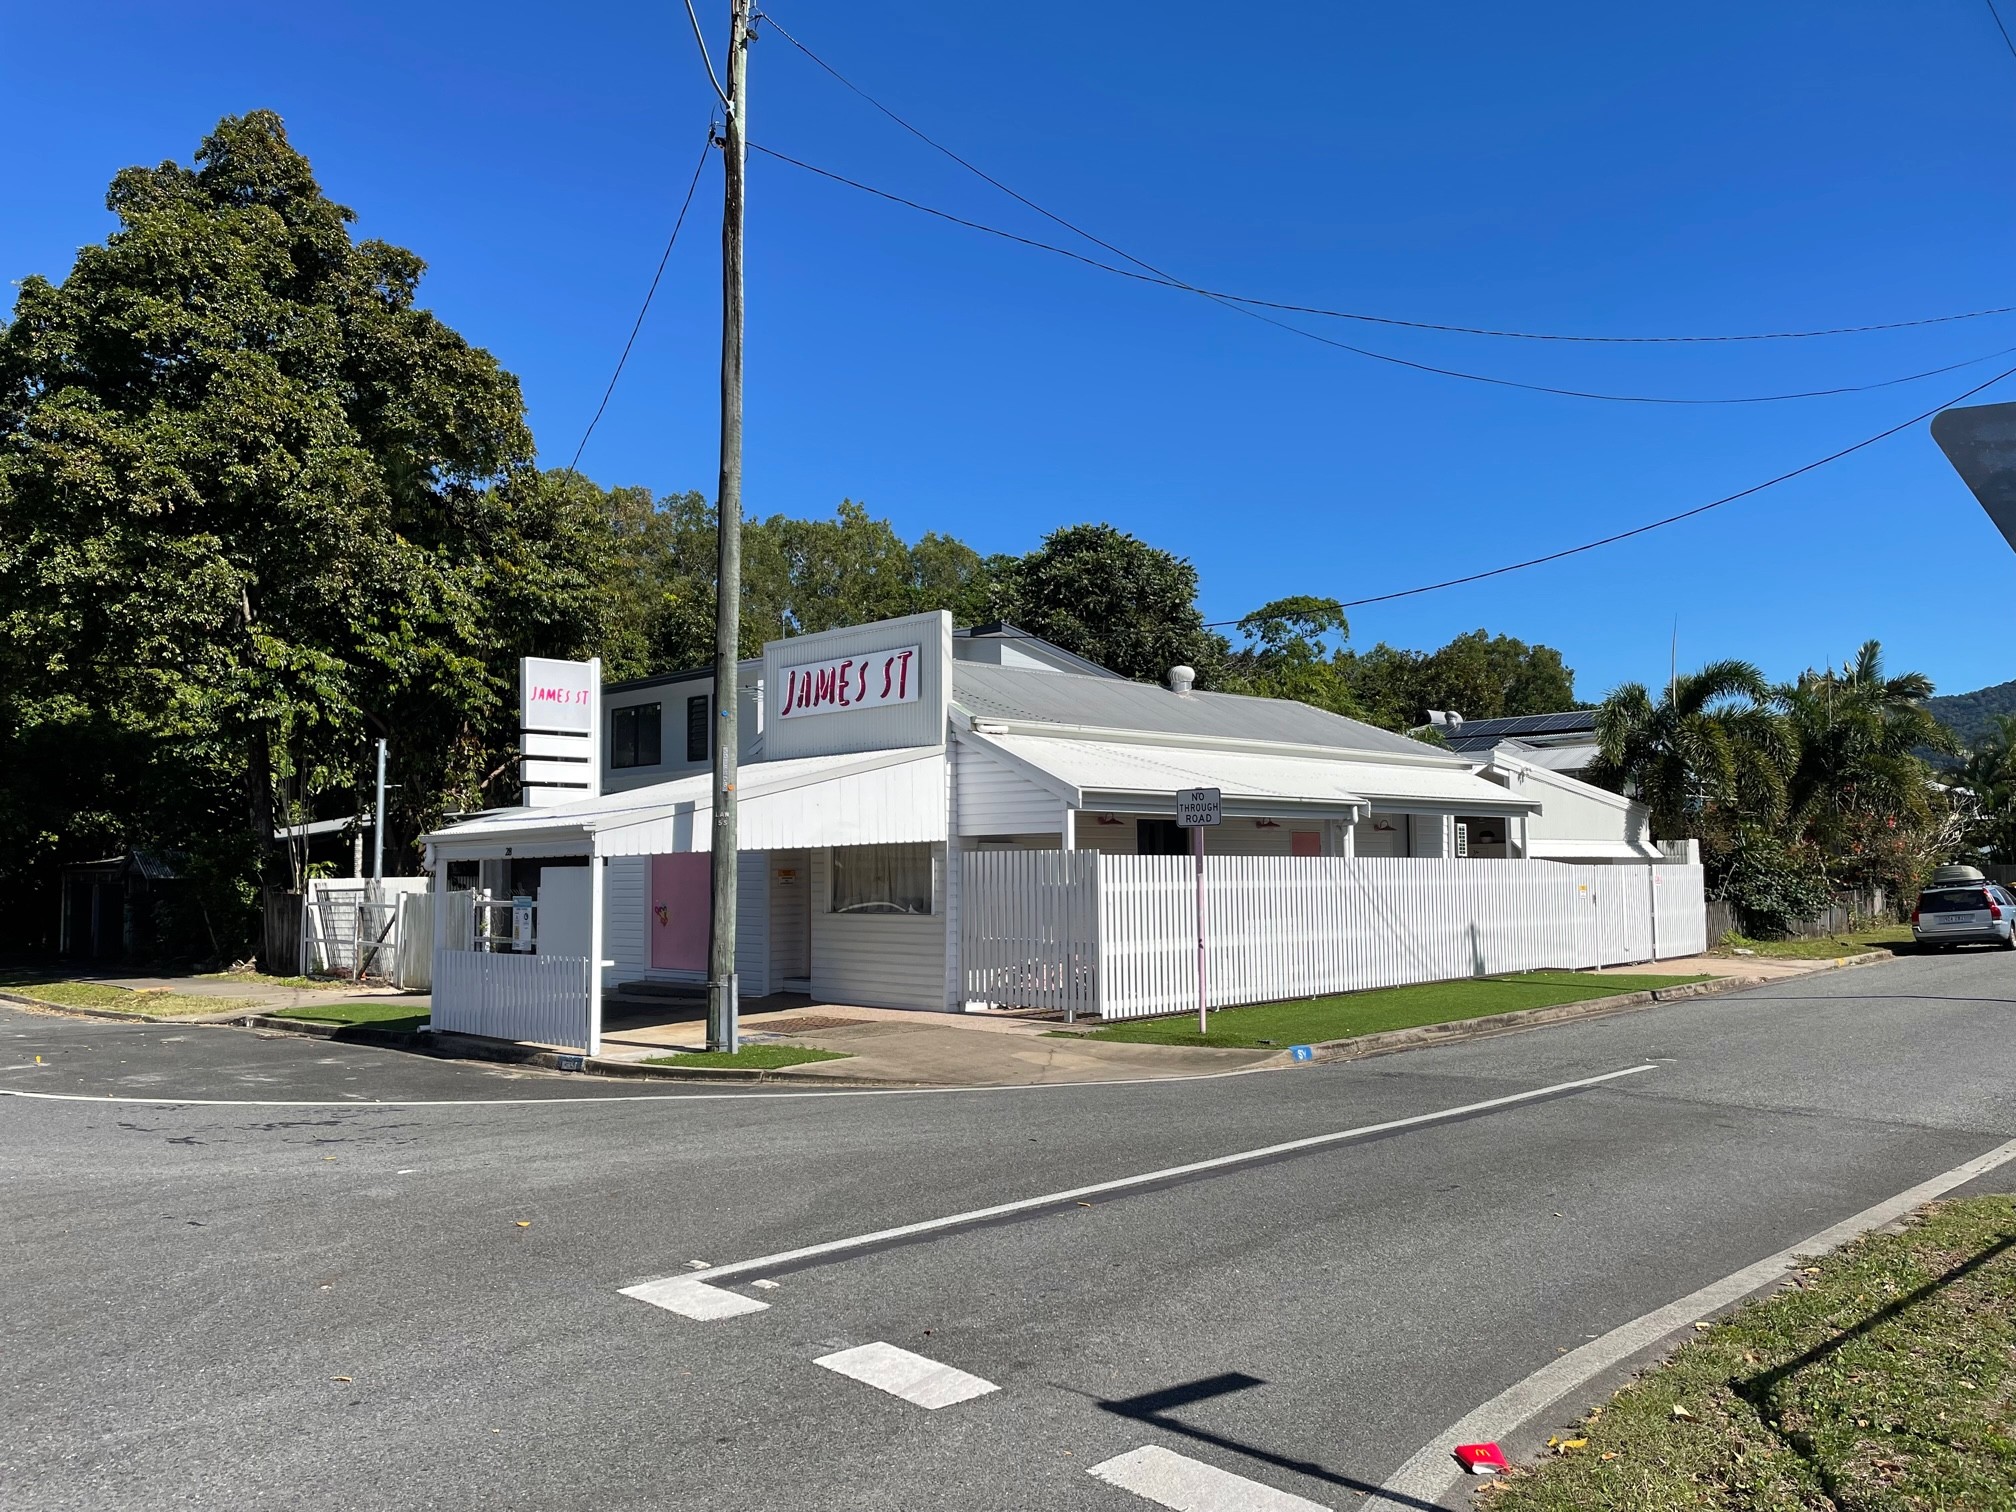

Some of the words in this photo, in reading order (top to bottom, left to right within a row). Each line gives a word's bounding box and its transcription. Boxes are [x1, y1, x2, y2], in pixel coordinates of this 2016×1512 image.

[782, 660, 869, 716] JAMES
[880, 650, 913, 699] ST
[530, 686, 571, 704] JAMES
[575, 690, 589, 705] ST
[1191, 792, 1205, 802] NO
[1179, 802, 1219, 812] THROUGH
[1185, 813, 1212, 823] ROAD
